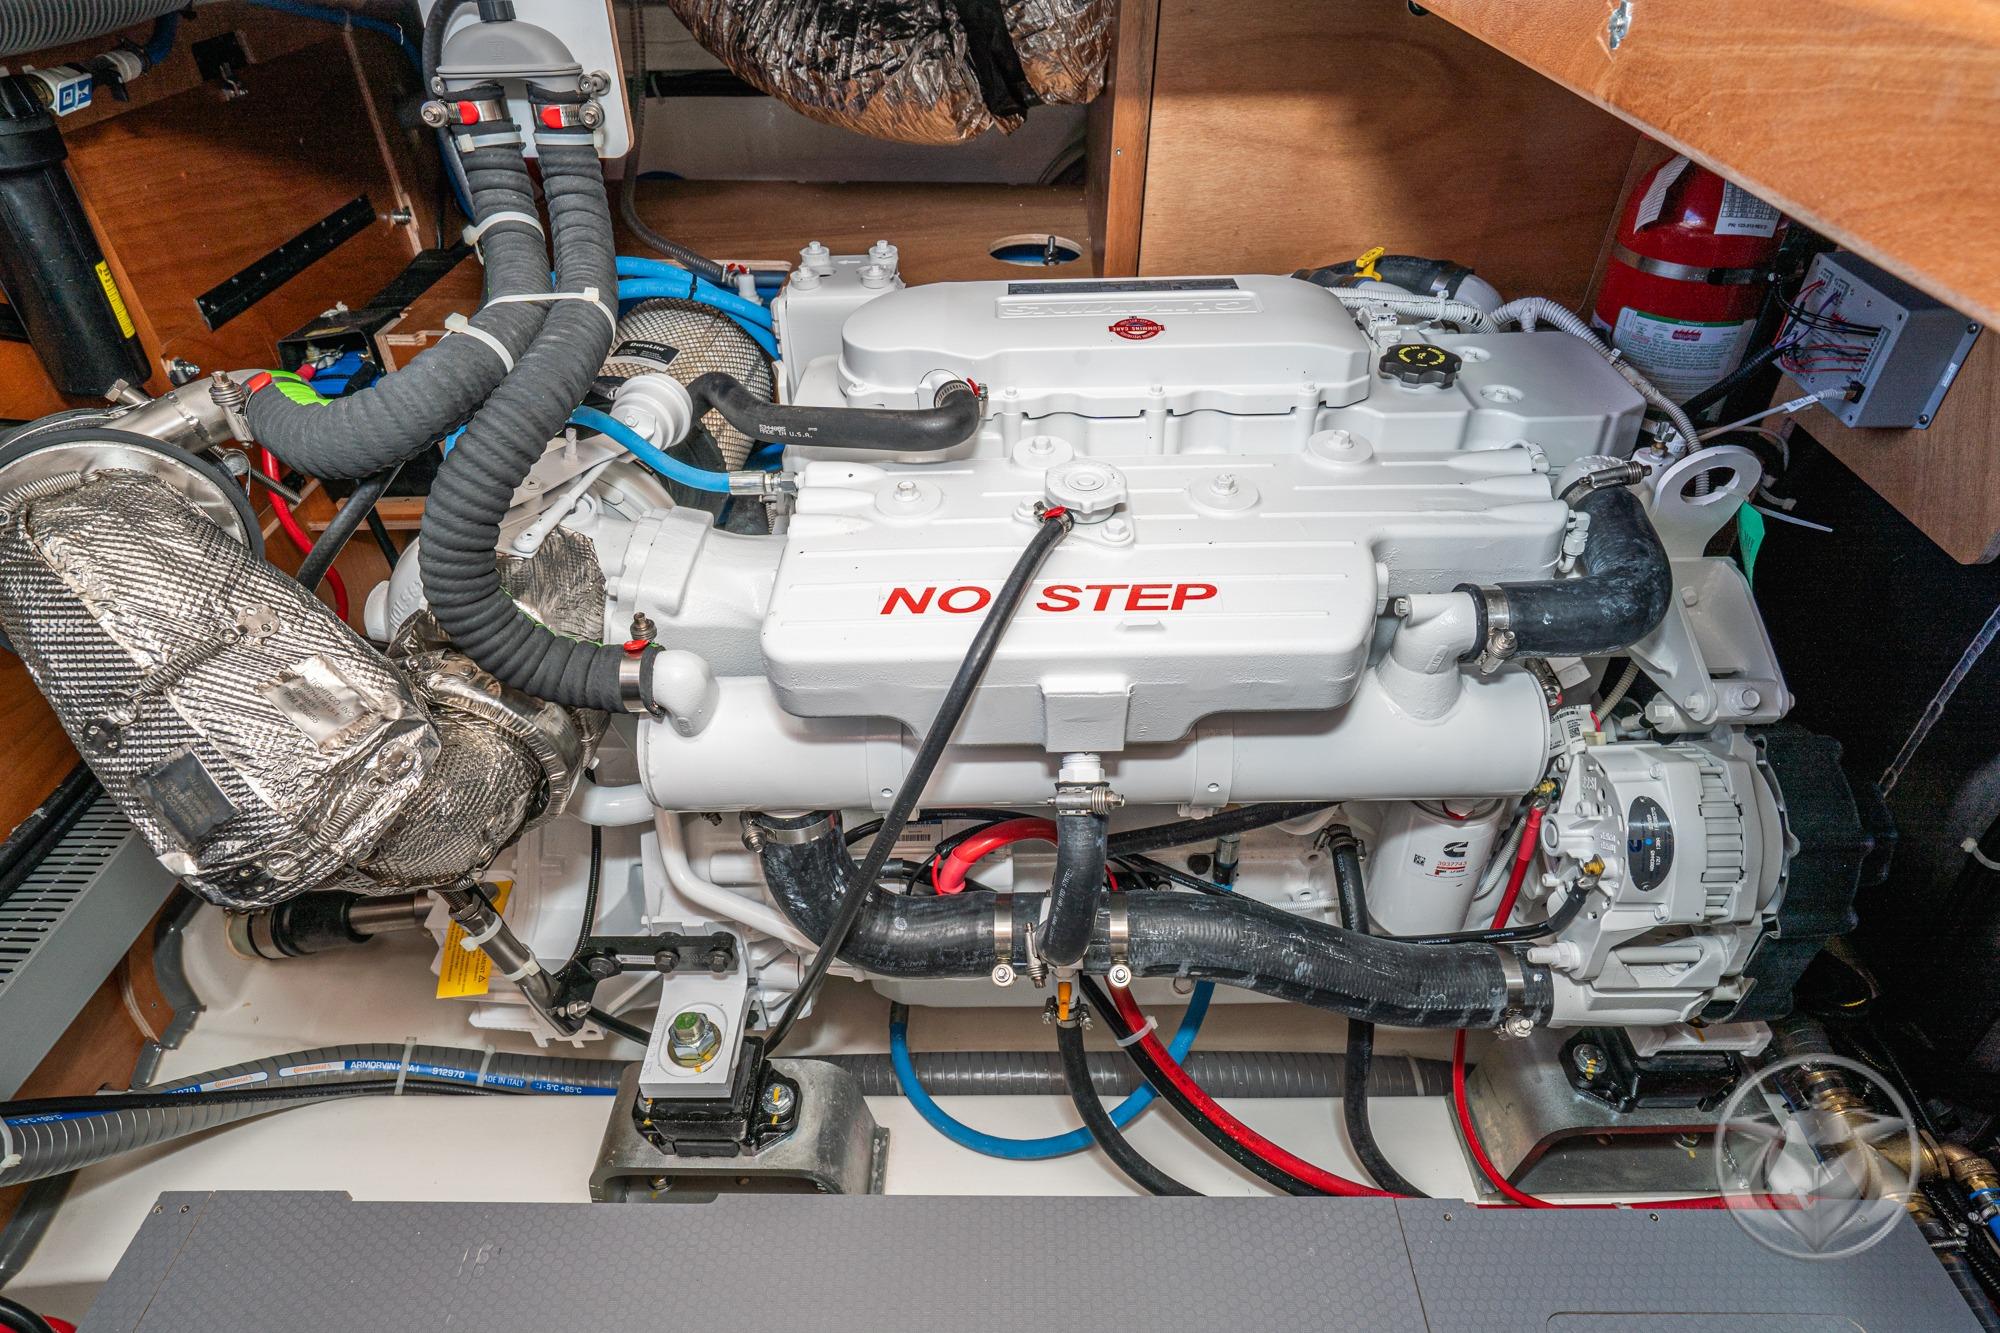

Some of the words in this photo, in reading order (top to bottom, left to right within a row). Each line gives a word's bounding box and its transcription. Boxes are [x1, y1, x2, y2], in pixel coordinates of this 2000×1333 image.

[880, 587, 991, 614] NO
[1036, 584, 1218, 612] STEP
[351, 1060, 395, 1070] ARMORVIN
[432, 1067, 465, 1079] 912970
[484, 1075, 498, 1084] ADE
[498, 1076, 506, 1085] IN
[507, 1078, 524, 1087] ITALY
